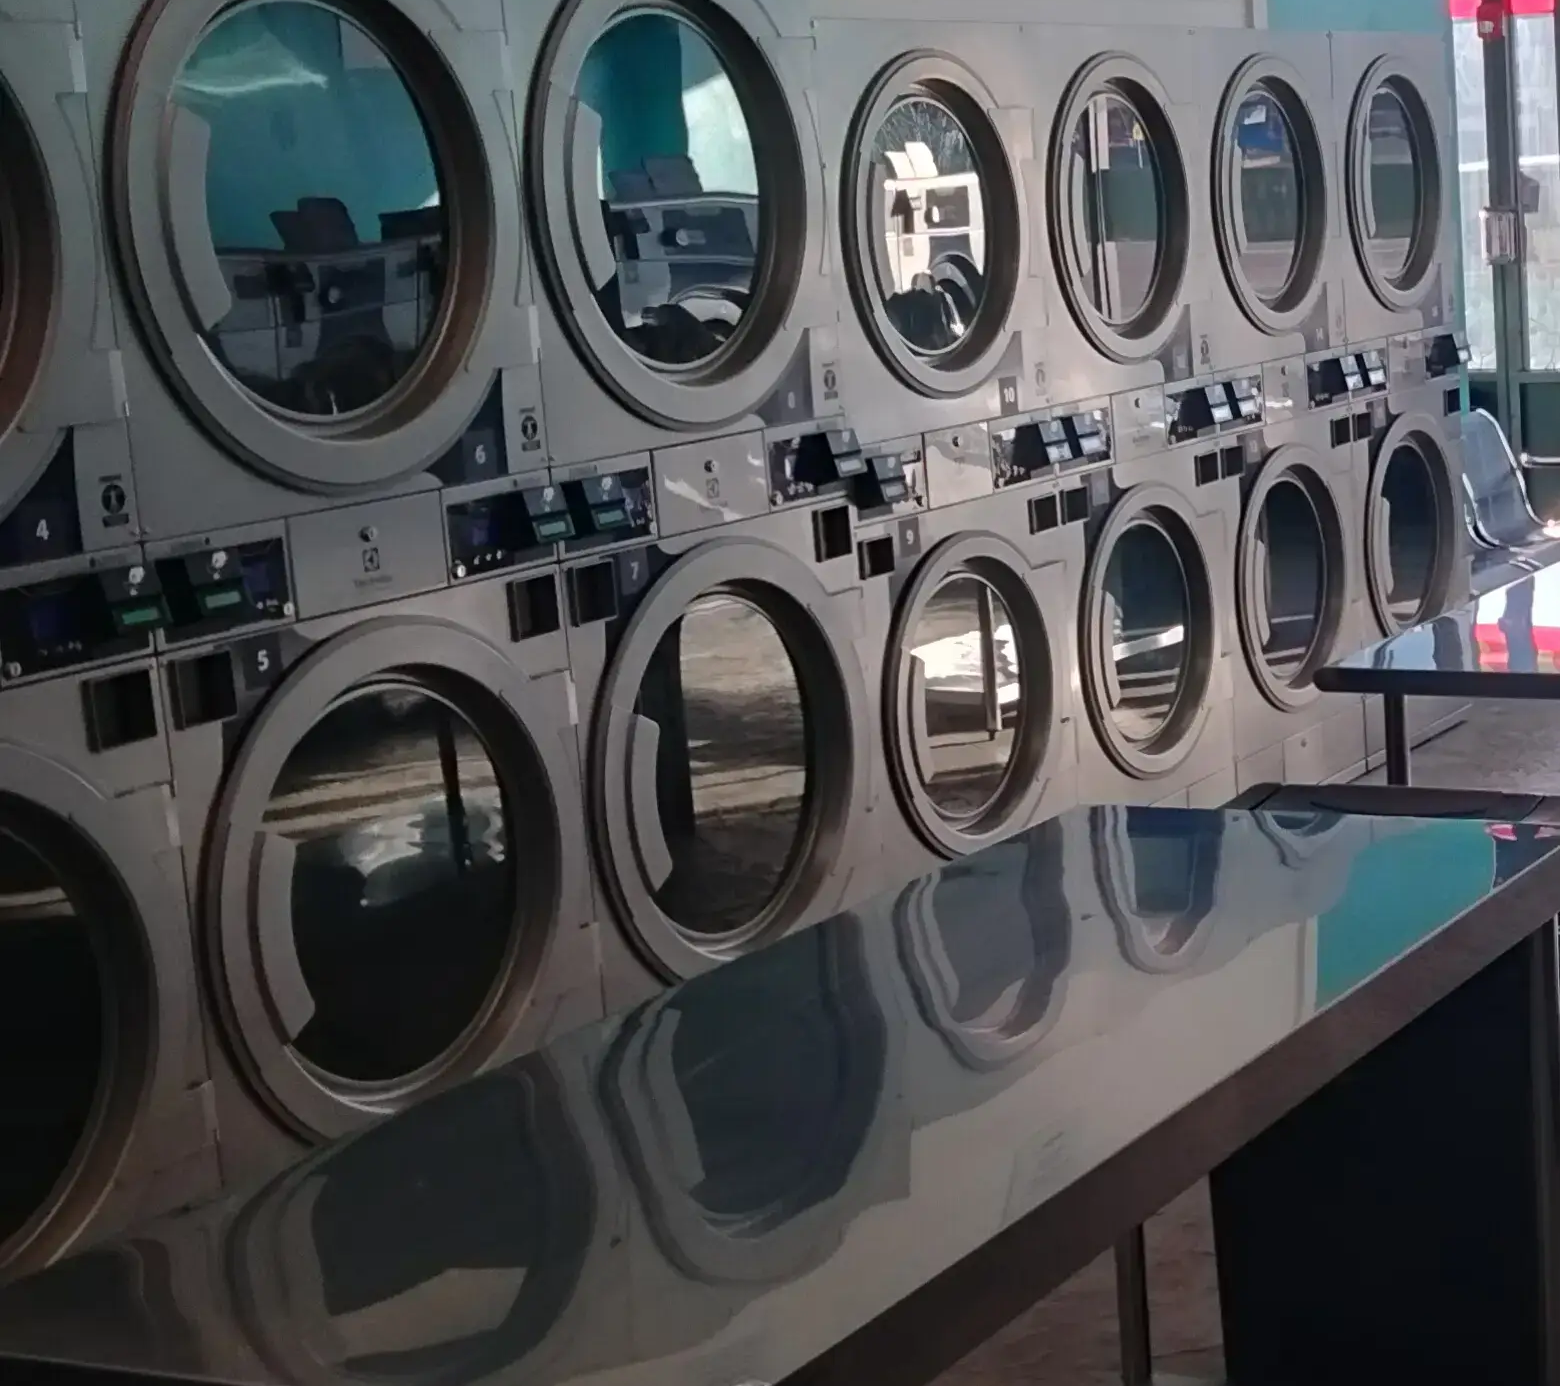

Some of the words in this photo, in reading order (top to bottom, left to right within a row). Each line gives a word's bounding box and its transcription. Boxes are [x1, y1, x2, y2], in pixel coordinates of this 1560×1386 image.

[1003, 386, 1016, 403] 10
[475, 444, 487, 465] 6
[35, 518, 50, 541] 4
[906, 528, 915, 545] 9
[630, 561, 641, 581] 7
[256, 649, 270, 672] 5
